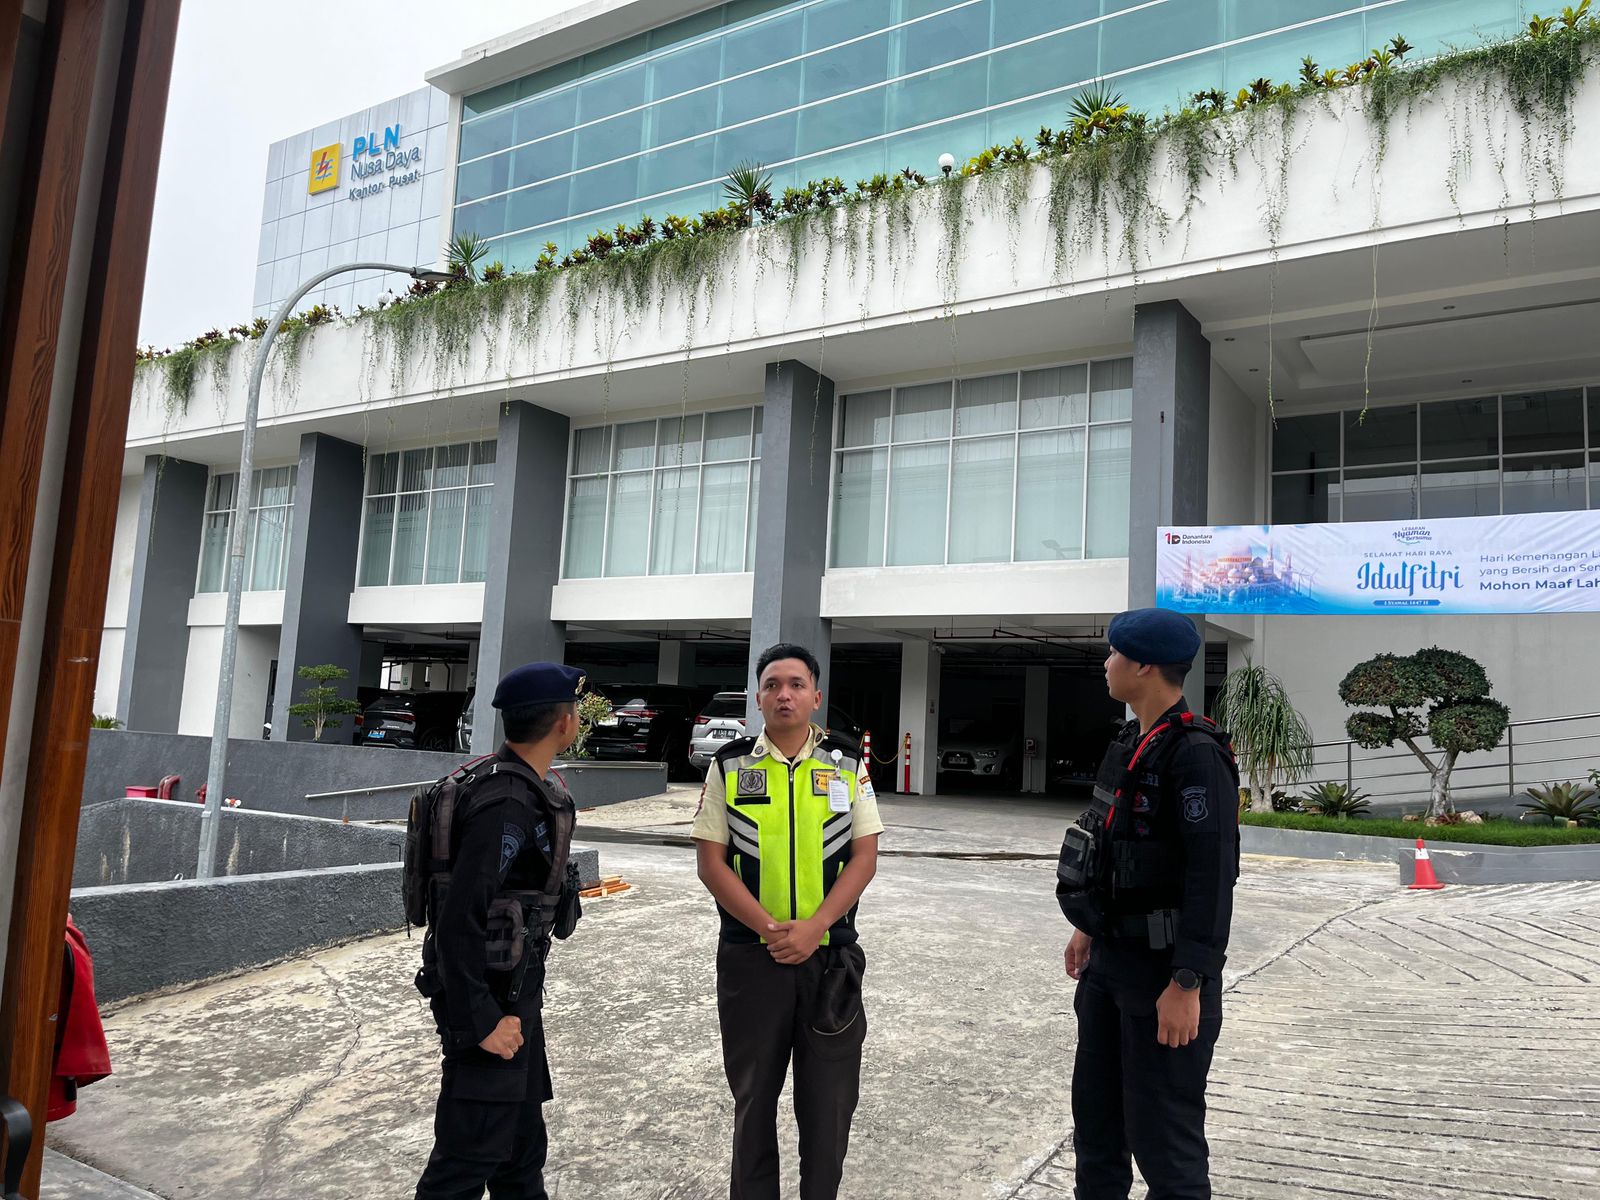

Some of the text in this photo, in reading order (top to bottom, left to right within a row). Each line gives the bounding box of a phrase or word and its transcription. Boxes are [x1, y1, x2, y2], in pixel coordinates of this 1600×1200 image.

[353, 123, 401, 161] PLN
[351, 146, 421, 181] Nusa Daya
[349, 169, 421, 200] Kantor Pusat
[1393, 530, 1431, 539] Nyaman
[1480, 554, 1504, 562] Hari
[1507, 551, 1588, 561] Kemenangan
[1479, 568, 1508, 577] yang
[1512, 565, 1549, 574] Bersih
[1553, 564, 1576, 573] dan
[1356, 560, 1464, 597] Idulfitri
[1480, 580, 1530, 590] Mohon
[1535, 578, 1573, 589] Maaf
[1025, 739, 1034, 751] P
